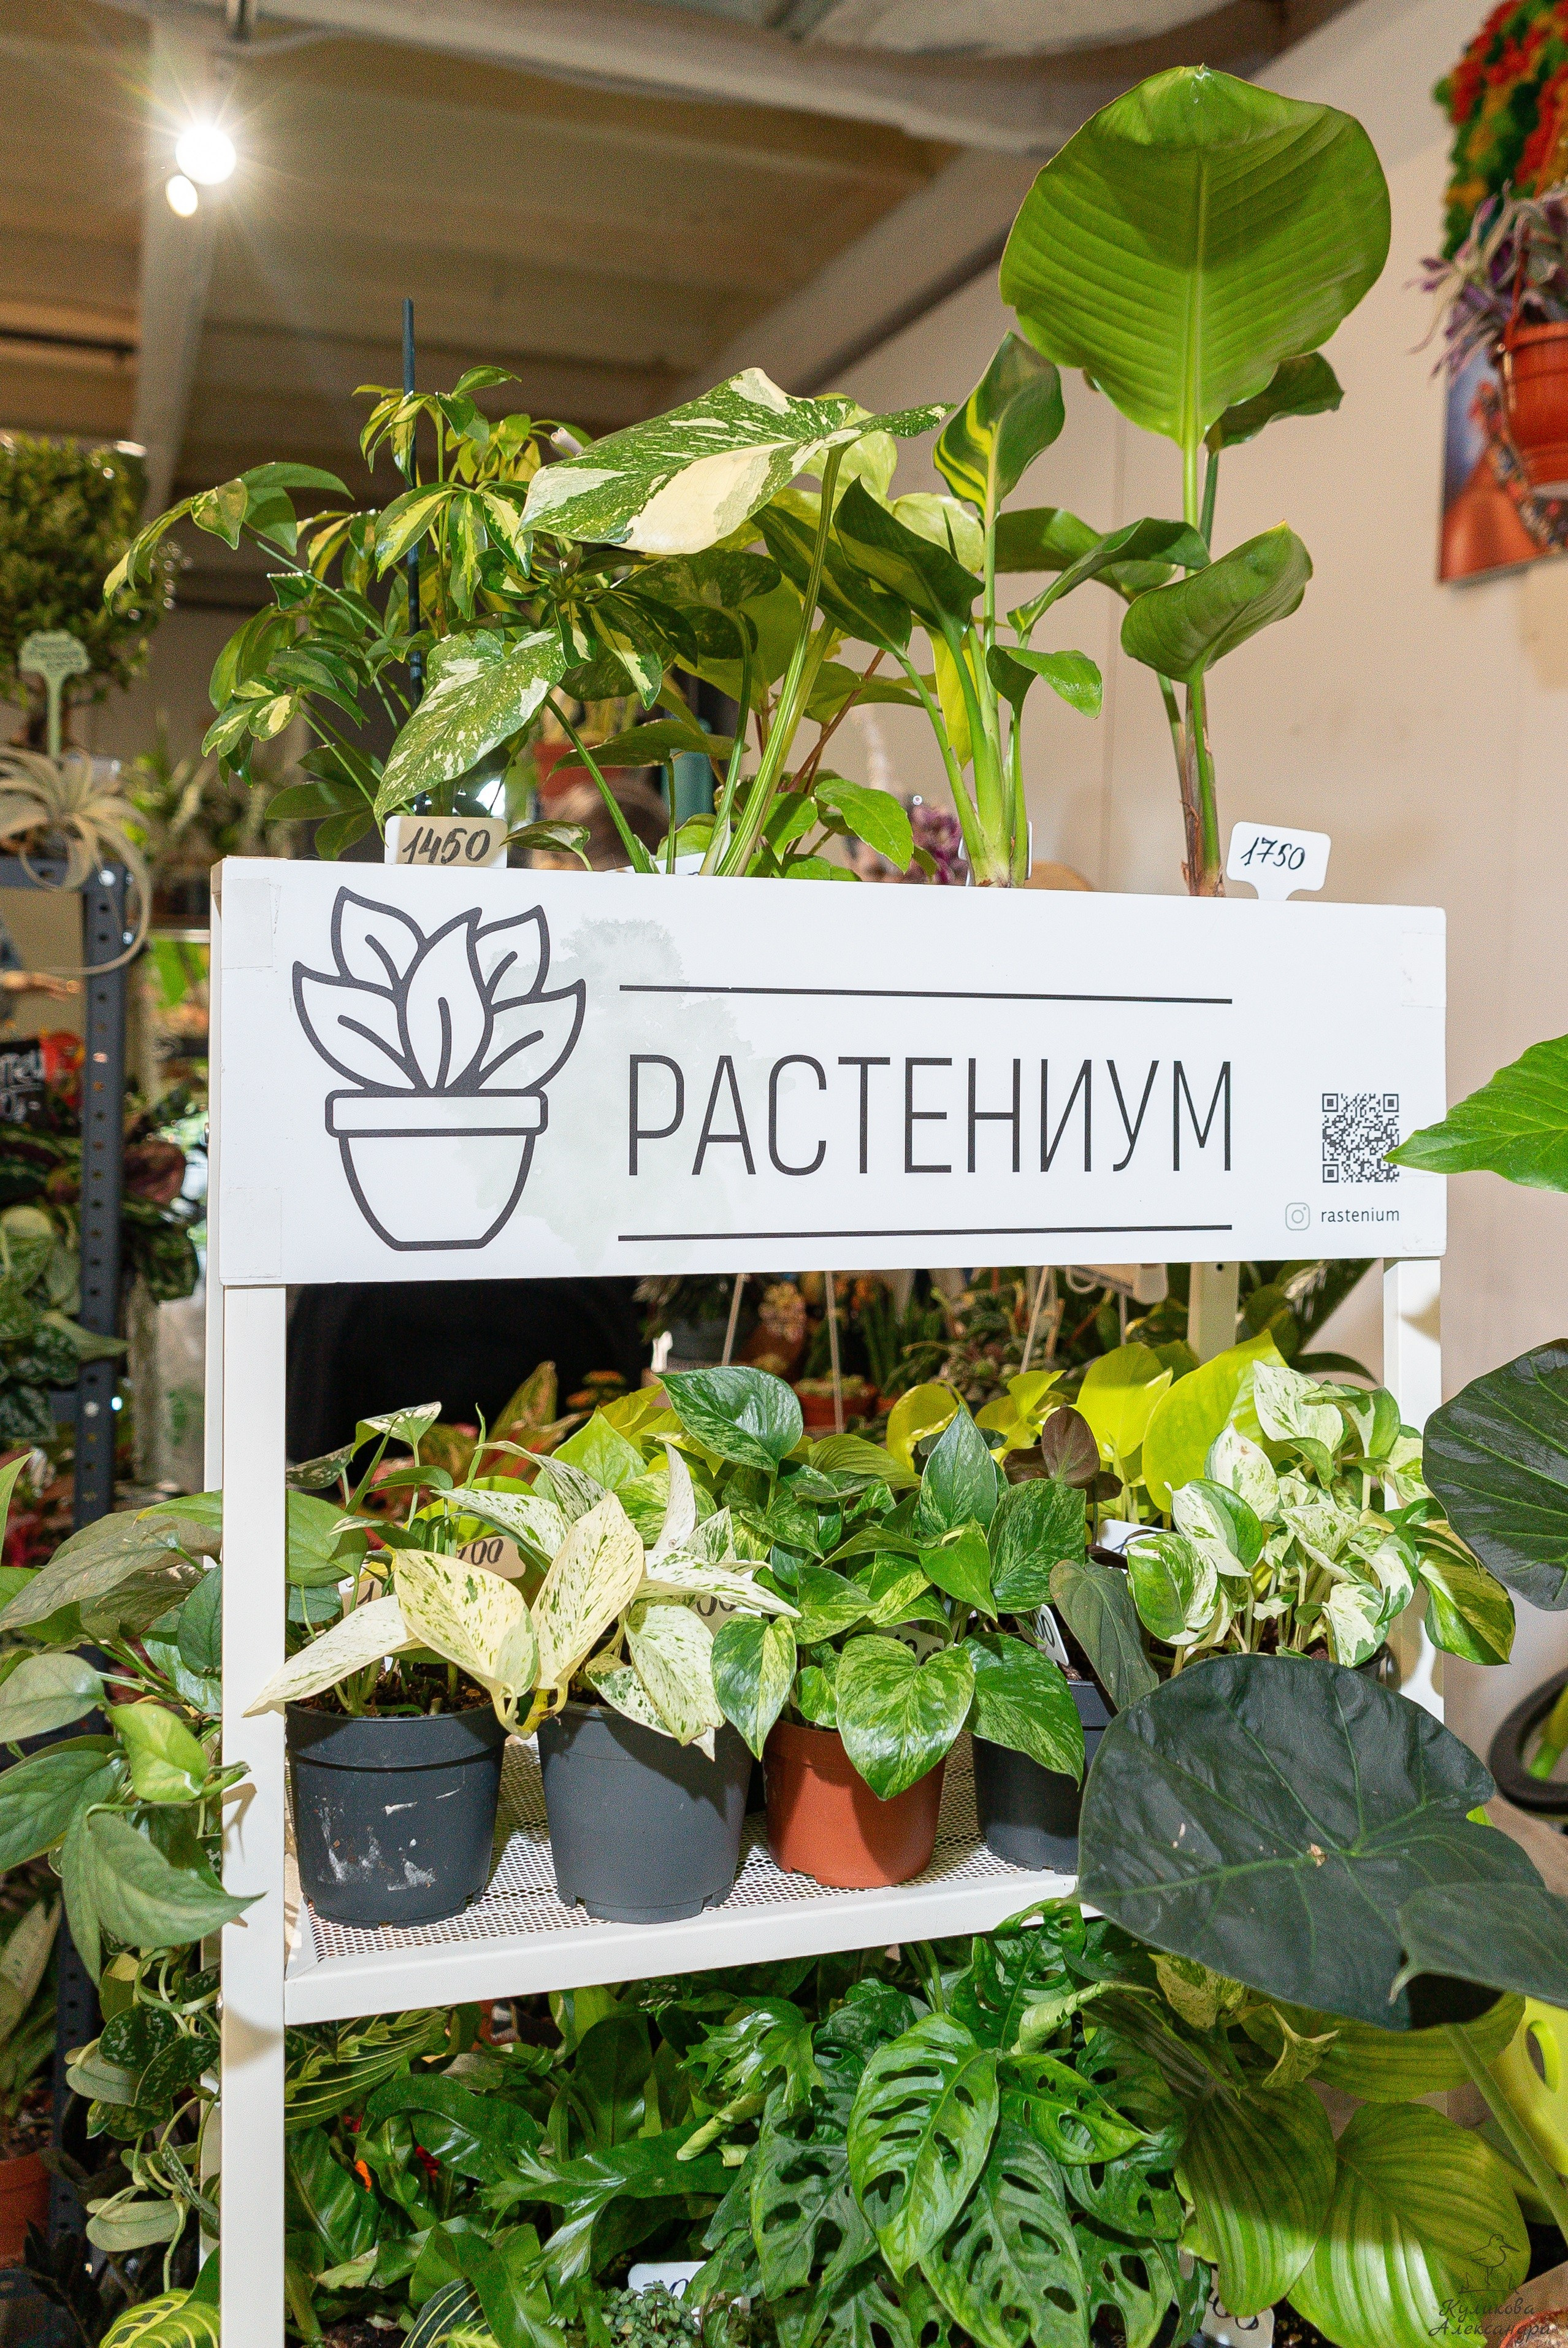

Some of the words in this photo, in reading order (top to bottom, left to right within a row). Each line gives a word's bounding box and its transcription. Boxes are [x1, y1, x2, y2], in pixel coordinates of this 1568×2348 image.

[402, 826, 491, 864] 1450
[1240, 837, 1305, 870] 1750
[629, 1054, 1231, 1175] РАСТЕНИУМ
[1321, 1207, 1399, 1222] rastenium
